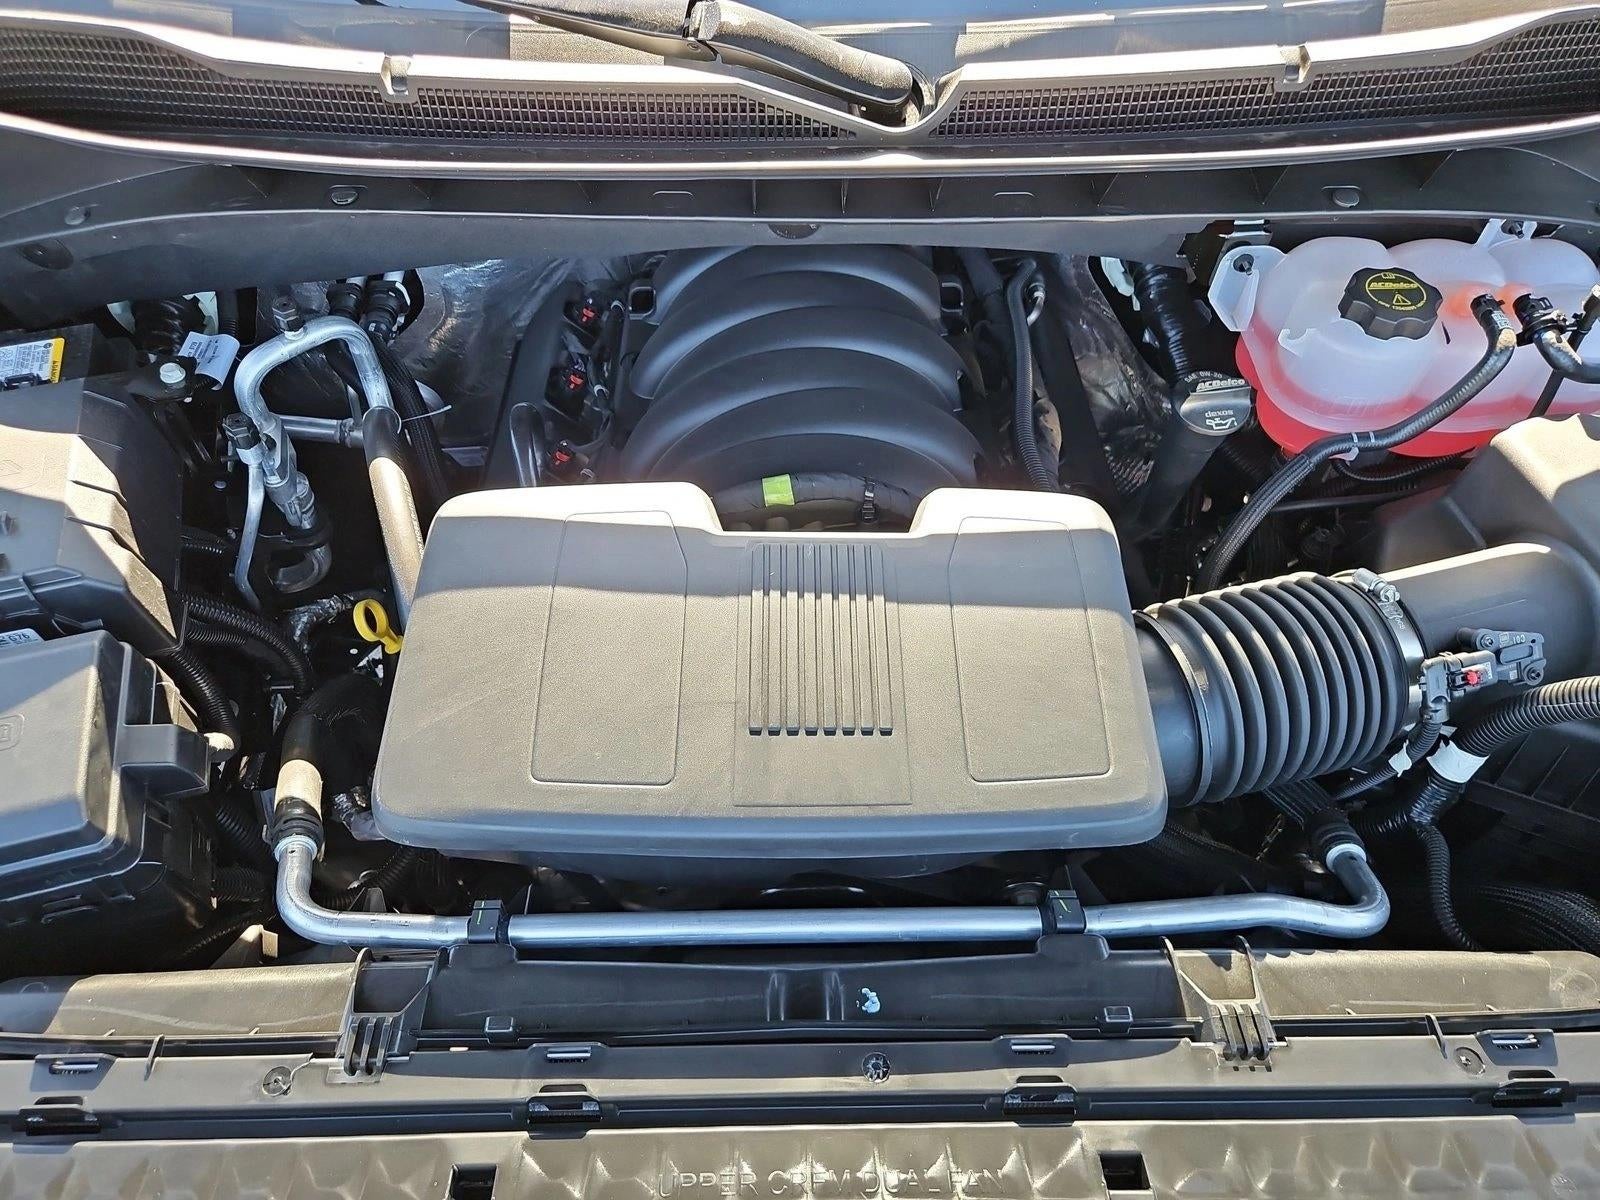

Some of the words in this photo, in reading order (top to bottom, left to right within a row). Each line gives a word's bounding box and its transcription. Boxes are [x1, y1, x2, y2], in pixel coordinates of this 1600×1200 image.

[1369, 281, 1419, 290] ACDelco
[1184, 372, 1198, 383] SAE
[1196, 378, 1246, 392] ACDelco
[1205, 410, 1234, 418] dexos
[658, 1171, 759, 1198] UPPER
[863, 1169, 941, 1194] DUAL
[947, 1169, 1003, 1194] FAN
